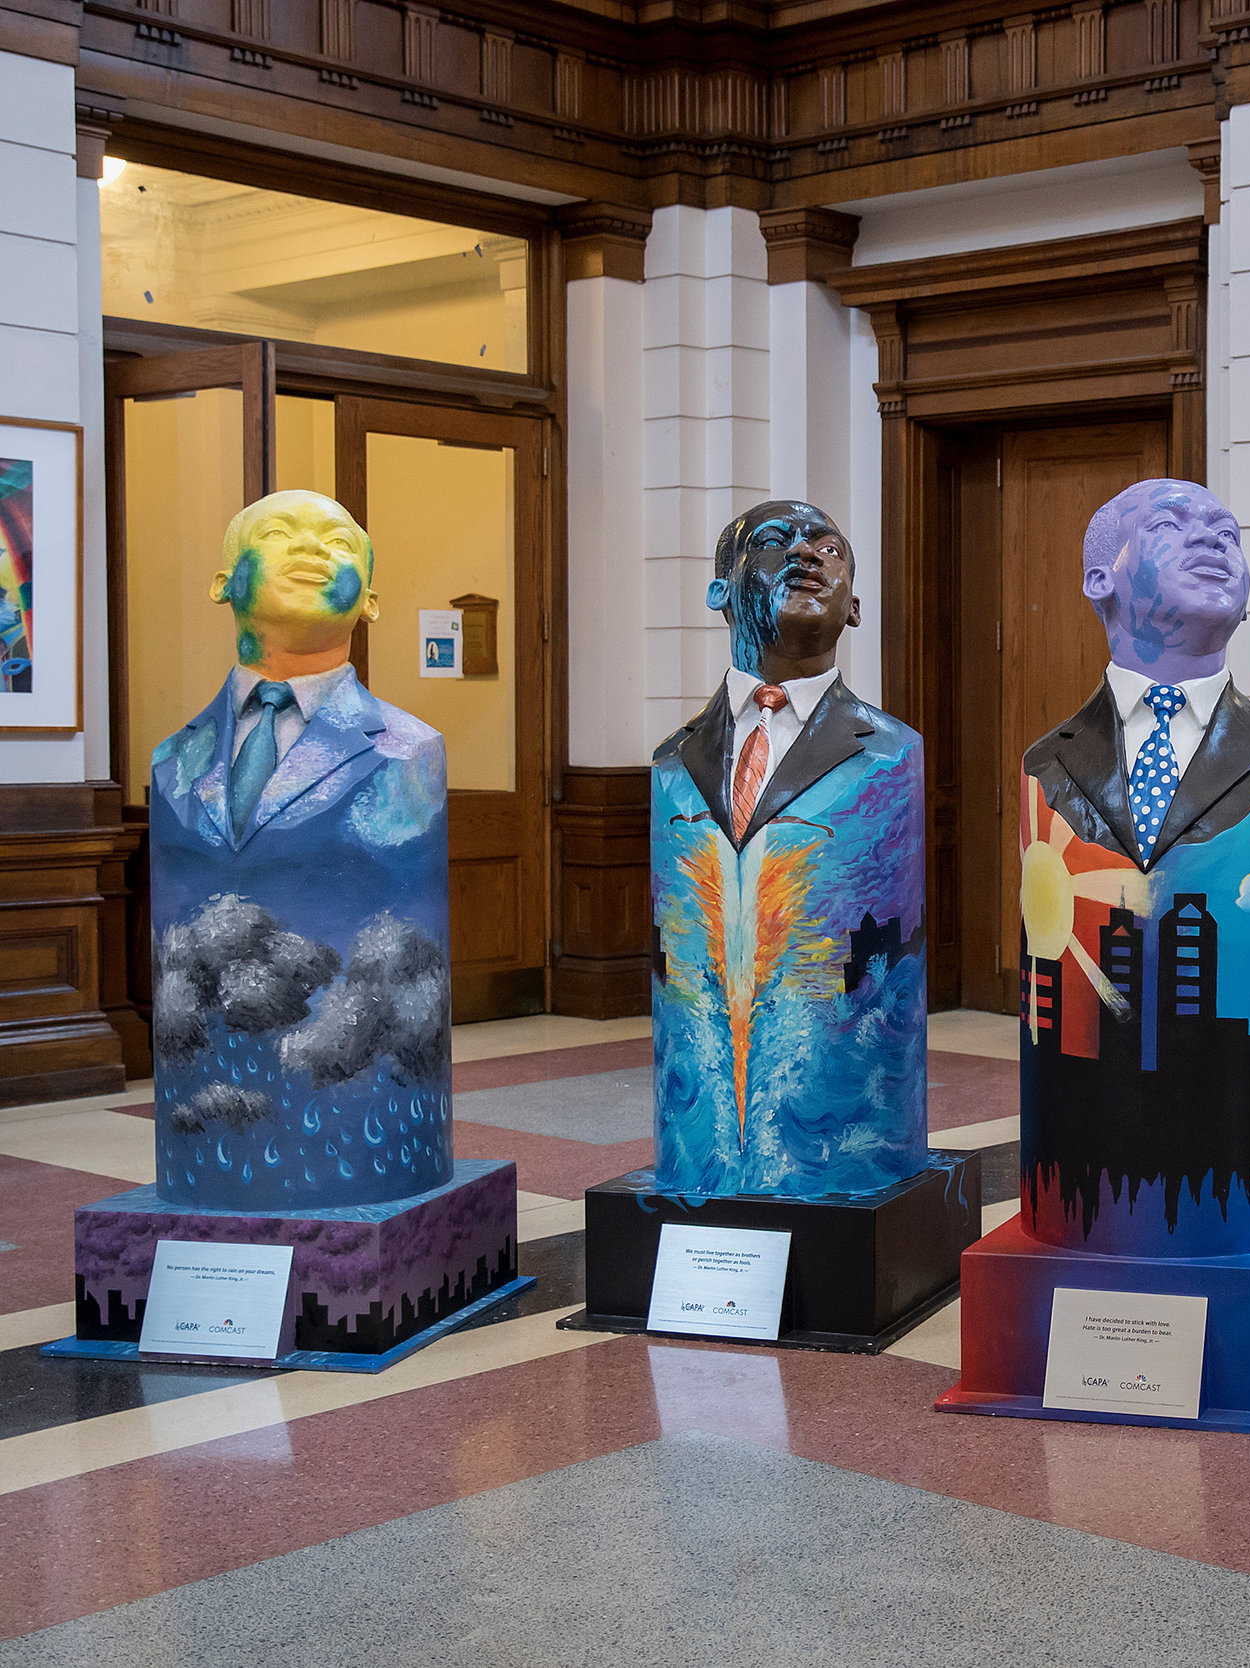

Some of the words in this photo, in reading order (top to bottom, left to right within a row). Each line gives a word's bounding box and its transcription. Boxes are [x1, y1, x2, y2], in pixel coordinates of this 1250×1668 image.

[712, 1307, 748, 1316] COMCAST
[208, 1325, 246, 1335] COMCAST
[1119, 1381, 1161, 1392] COMCAST
